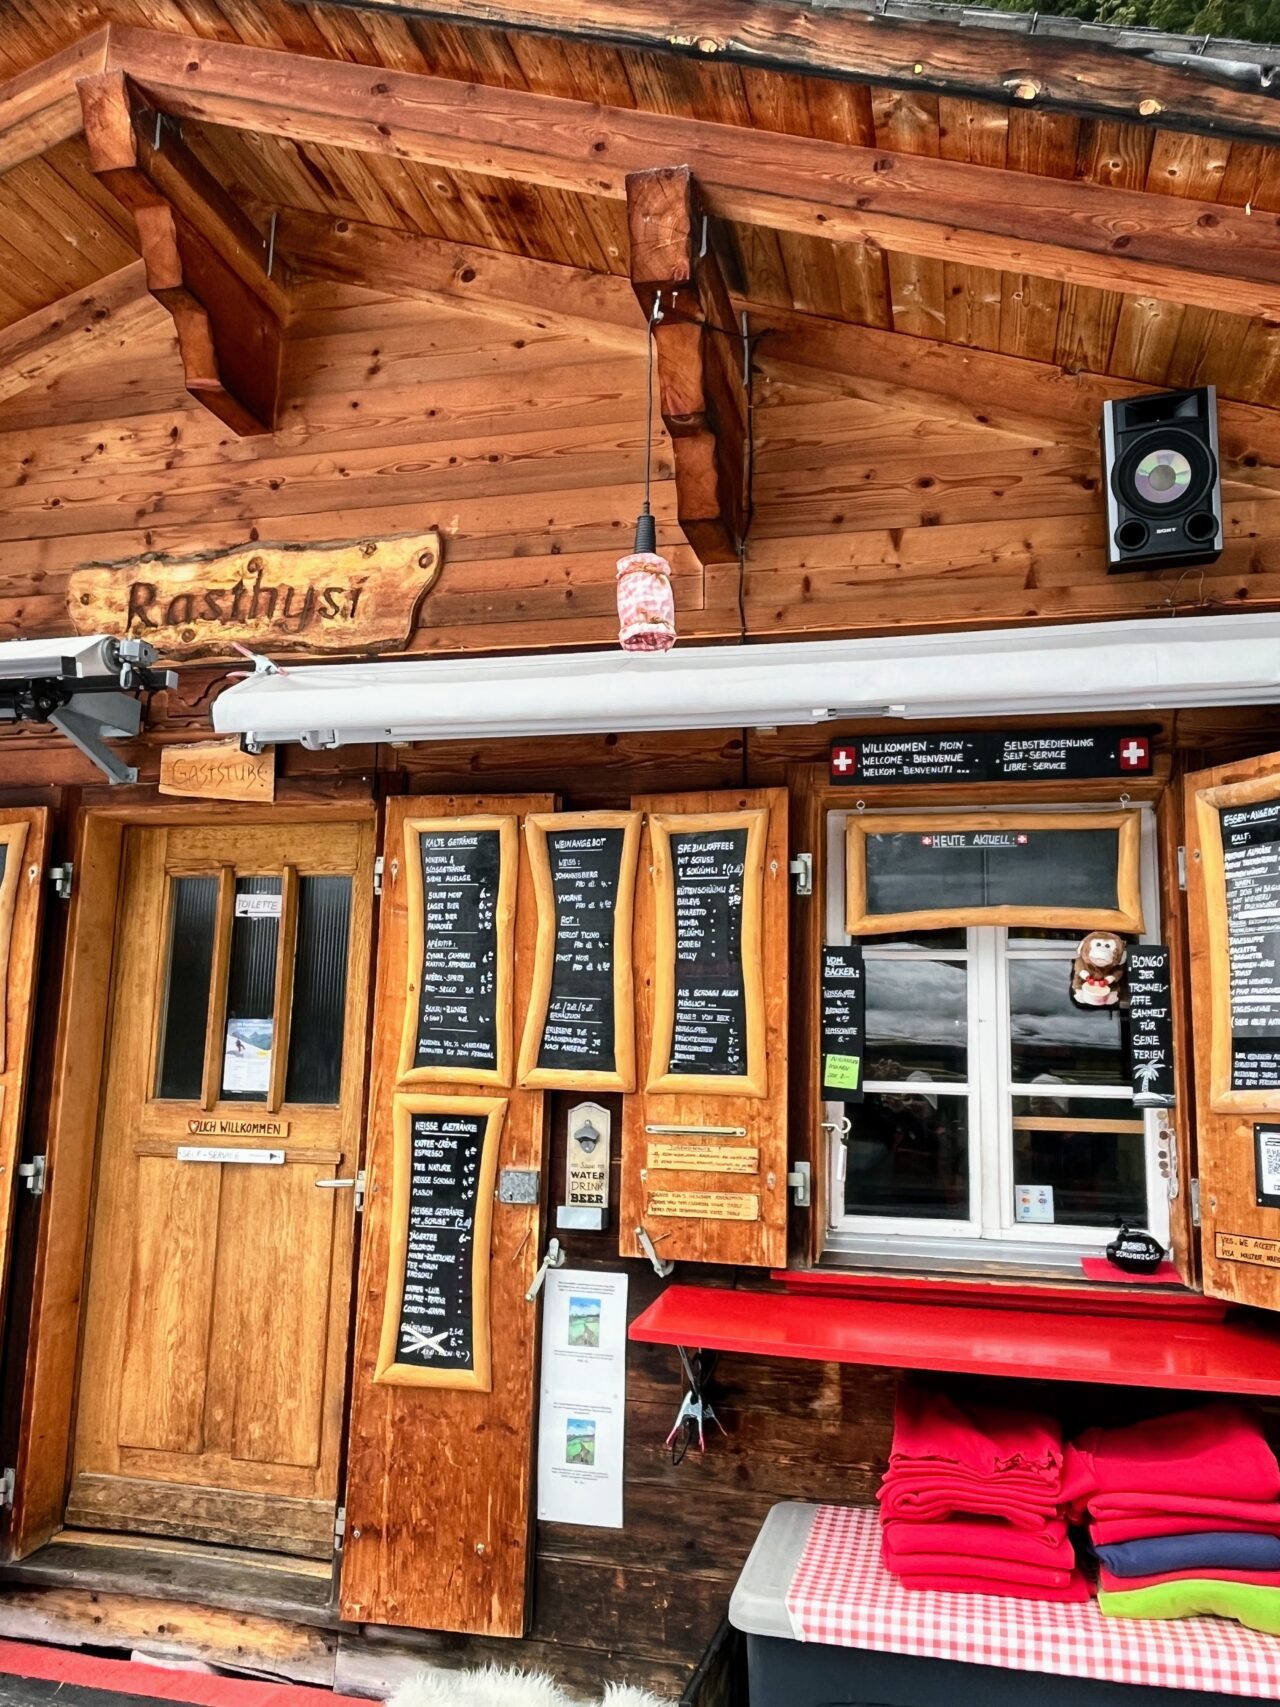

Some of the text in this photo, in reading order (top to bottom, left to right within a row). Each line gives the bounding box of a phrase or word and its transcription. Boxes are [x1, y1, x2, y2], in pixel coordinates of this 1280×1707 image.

[125, 567, 369, 634] Rasthysi
[862, 740, 964, 754] WILLKOMMEN MOIN
[1003, 738, 1094, 750] SELBSTBEDIENUNG
[862, 754, 964, 766] WELCOME BIENVENUE
[172, 758, 268, 790] GASTSTUBE
[863, 766, 953, 777] WELKOM BENVENUTI
[426, 836, 478, 848] KALTE GETRÄNKE
[554, 838, 606, 849] WEINANGEBOT
[932, 834, 966, 847] HEUTE
[677, 842, 734, 854] SPEZIALKAFFEES
[238, 899, 278, 910] TOILETTE
[426, 902, 444, 910] LAGER
[1138, 970, 1154, 980] DER
[1128, 983, 1168, 992] TROMMEL-
[1131, 1008, 1167, 1019] SAMMELT
[1140, 1019, 1156, 1031] FÜR
[1133, 1034, 1160, 1045] SEINE
[1133, 1049, 1165, 1060] FERIEN
[220, 1121, 280, 1134] WILLKOMMEN
[415, 1120, 477, 1132] HEISSE GETRÄNKE
[414, 1149, 443, 1157] ESPRESSO
[571, 1181, 603, 1191] DRINK
[570, 1194, 604, 1204] BEER
[411, 1206, 464, 1217] HEISSE GETRÄNKE
[409, 1230, 438, 1242] JÄGERTEE
[1239, 1238, 1248, 1247] WE
